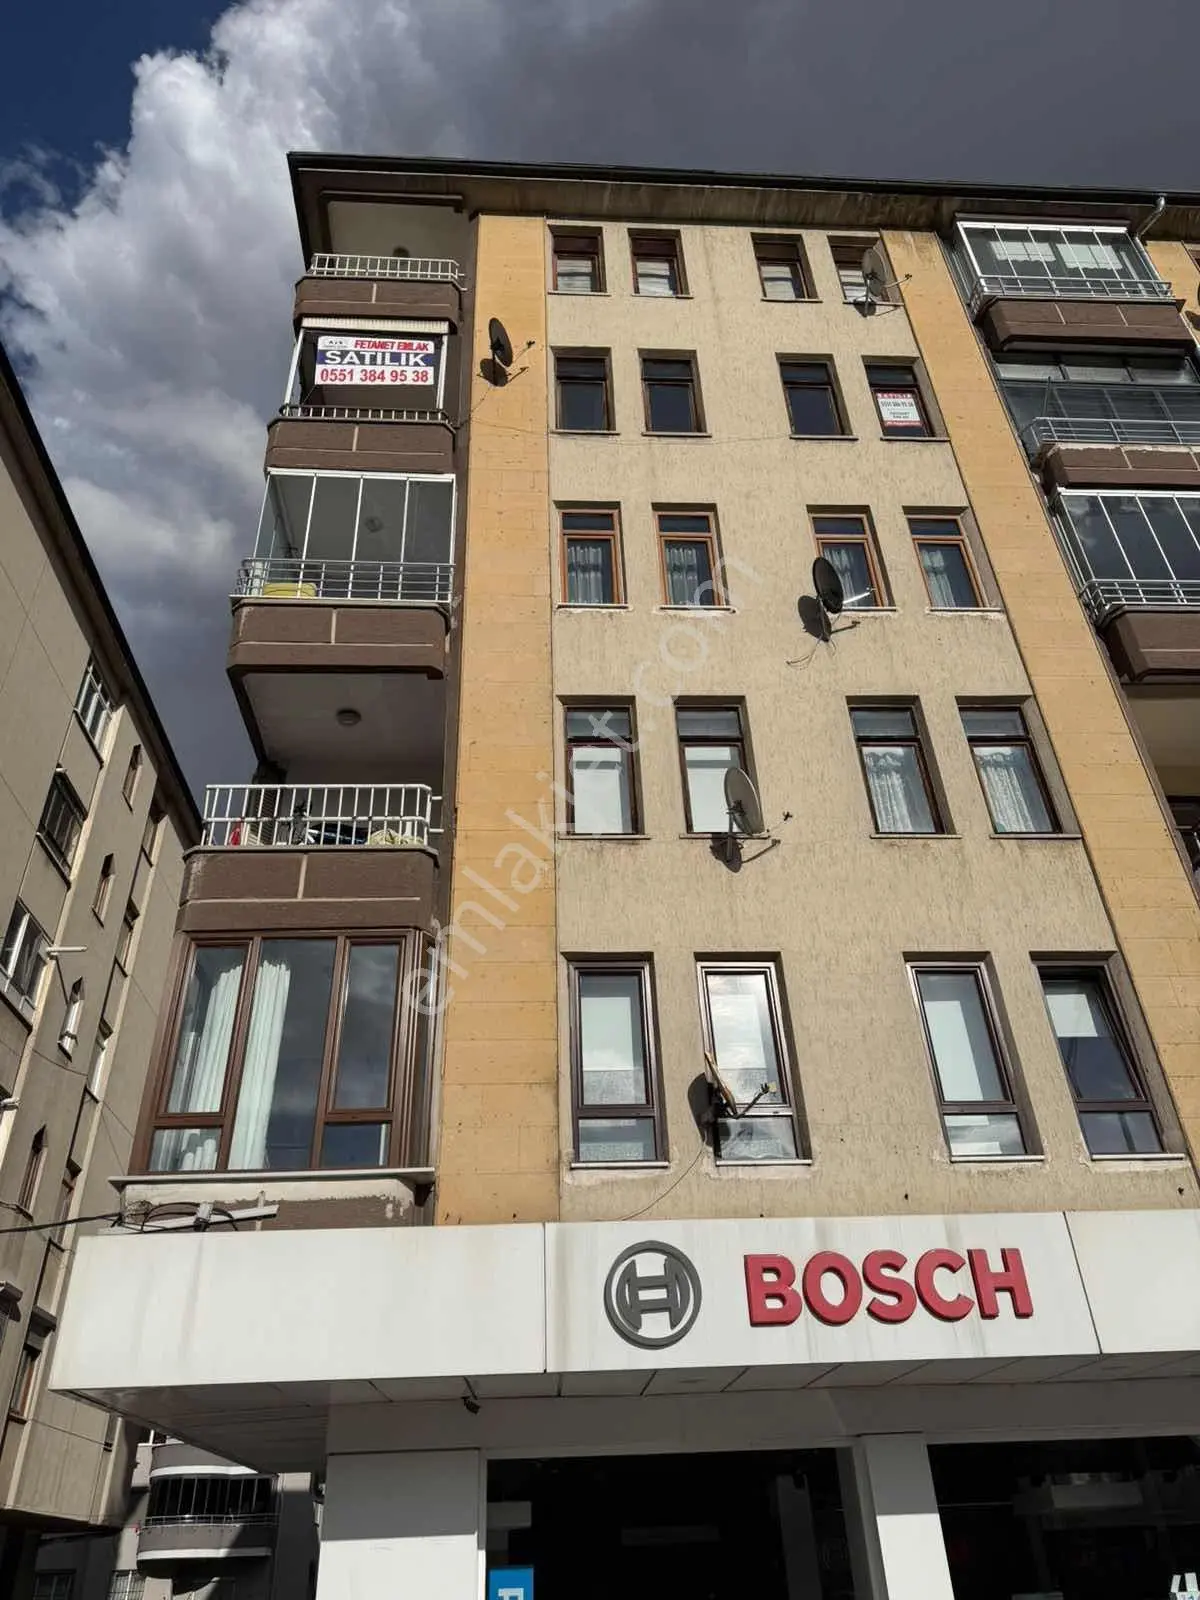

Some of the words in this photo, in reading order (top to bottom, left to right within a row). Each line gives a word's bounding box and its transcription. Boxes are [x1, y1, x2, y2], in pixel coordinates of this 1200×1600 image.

[397, 341, 429, 351] EMLAK
[325, 350, 427, 366] SATILIK
[320, 368, 354, 382] 0551
[360, 369, 386, 382] 384
[390, 369, 408, 382] 95
[412, 370, 429, 382] 38
[744, 1248, 1034, 1327] BOSCH
